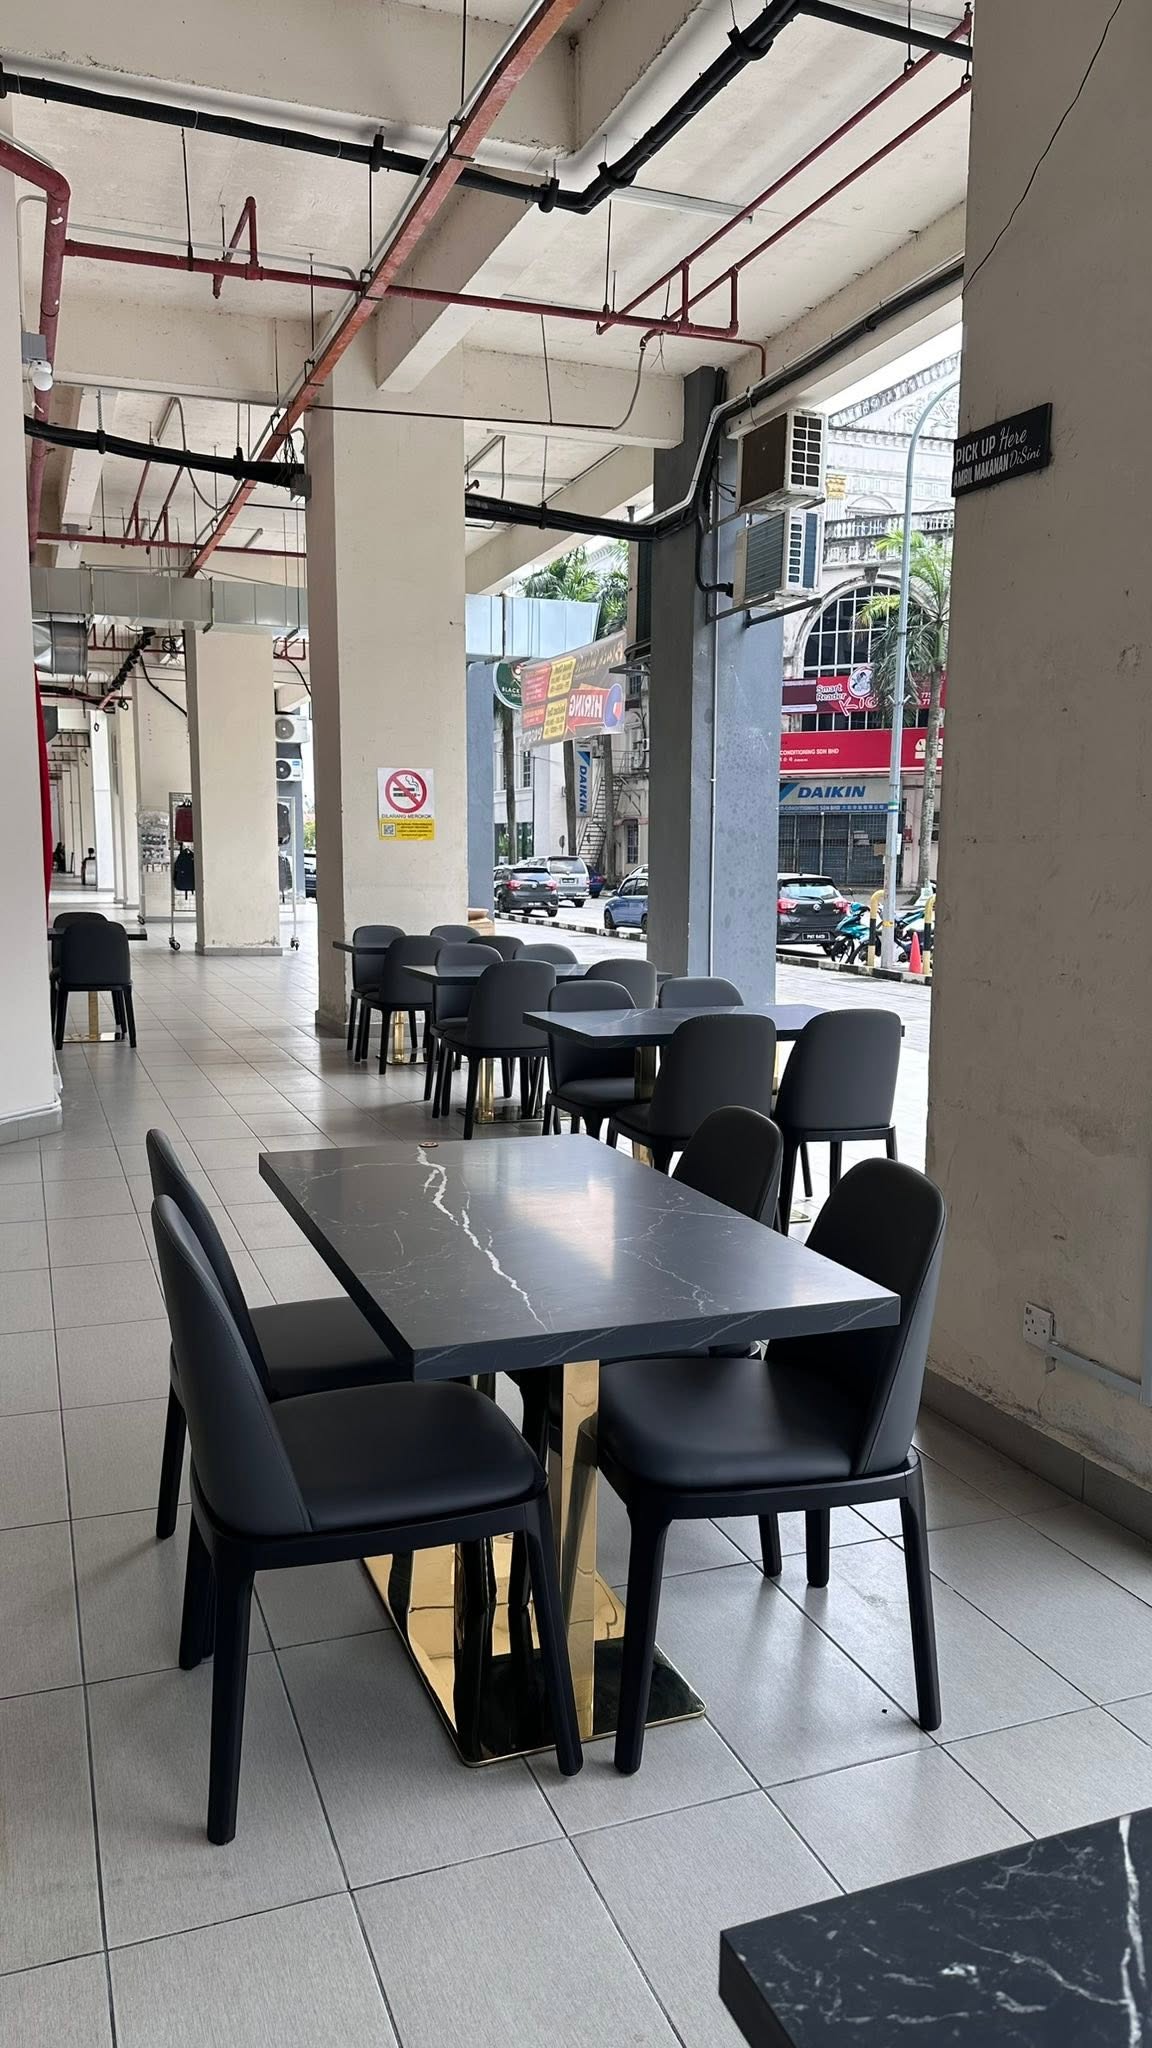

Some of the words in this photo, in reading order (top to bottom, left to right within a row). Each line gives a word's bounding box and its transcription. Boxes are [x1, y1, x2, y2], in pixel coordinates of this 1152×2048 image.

[955, 442, 979, 466] PICK
[981, 435, 996, 457] UP
[999, 425, 1027, 451] Here
[953, 467, 973, 488] AMBIL
[975, 453, 1009, 481] MAKANAN
[501, 686, 521, 694] BLACK
[816, 683, 842, 693] Smart
[816, 692, 847, 702] Reader
[578, 765, 588, 814] DAIKIN
[798, 785, 867, 798] DAIKIN
